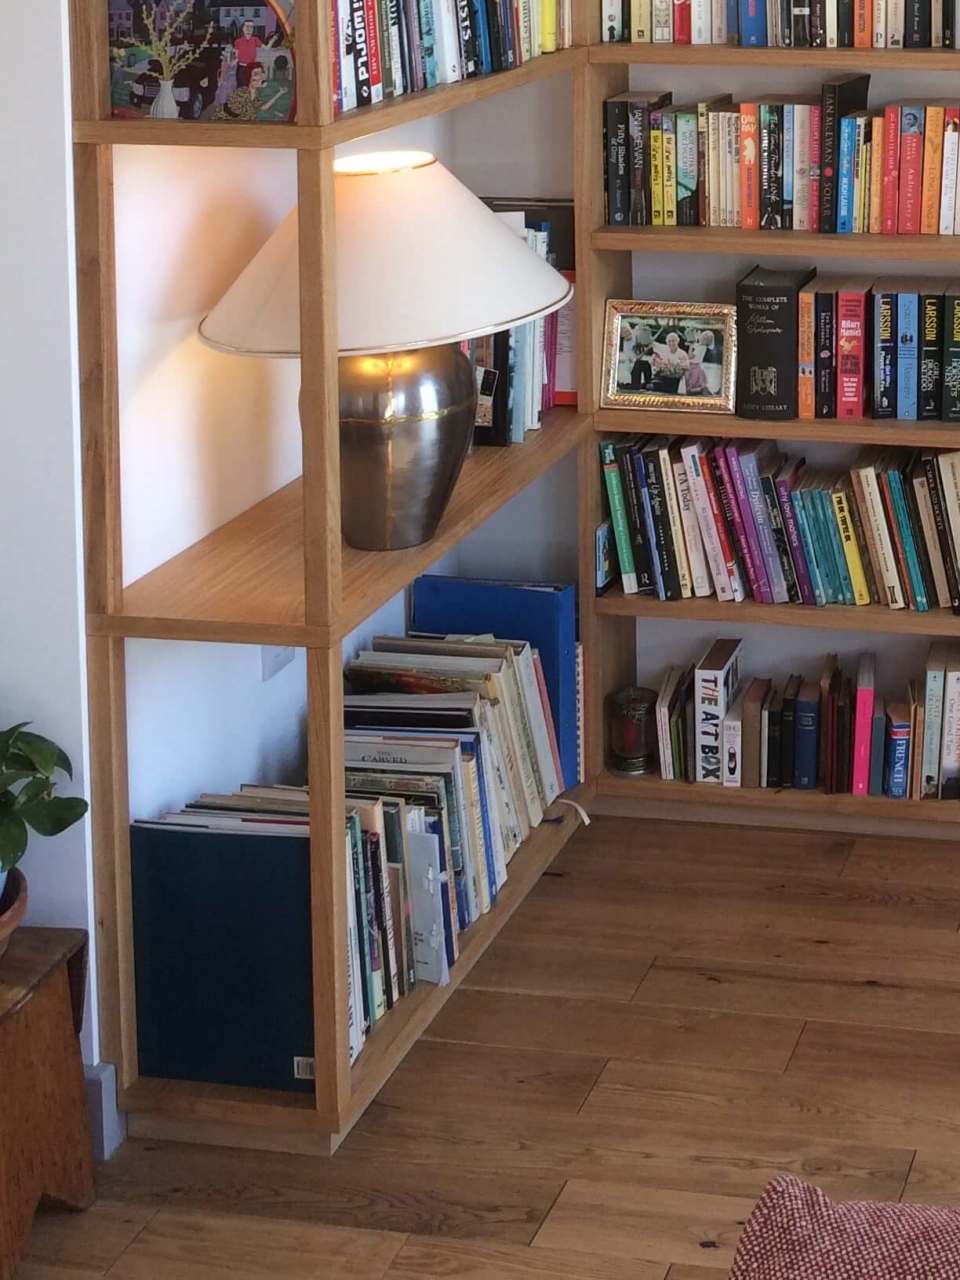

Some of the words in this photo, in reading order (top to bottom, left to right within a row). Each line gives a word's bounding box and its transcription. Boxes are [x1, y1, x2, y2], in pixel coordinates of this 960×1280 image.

[826, 94, 837, 113] IAN
[824, 116, 836, 163] McEWAN
[907, 167, 915, 197] Andrea
[823, 182, 835, 217] SOLAR
[880, 298, 891, 339] LARSSON
[926, 299, 937, 340] LARSSON
[926, 359, 934, 391] DRAGON
[944, 366, 952, 386] NEST
[678, 471, 688, 485] TA
[681, 487, 692, 512] Today
[780, 486, 790, 502] why
[783, 502, 792, 519] love
[787, 519, 799, 547] matters
[701, 676, 719, 706] THE
[701, 744, 721, 781] BOX
[893, 740, 907, 782] FRENCH
